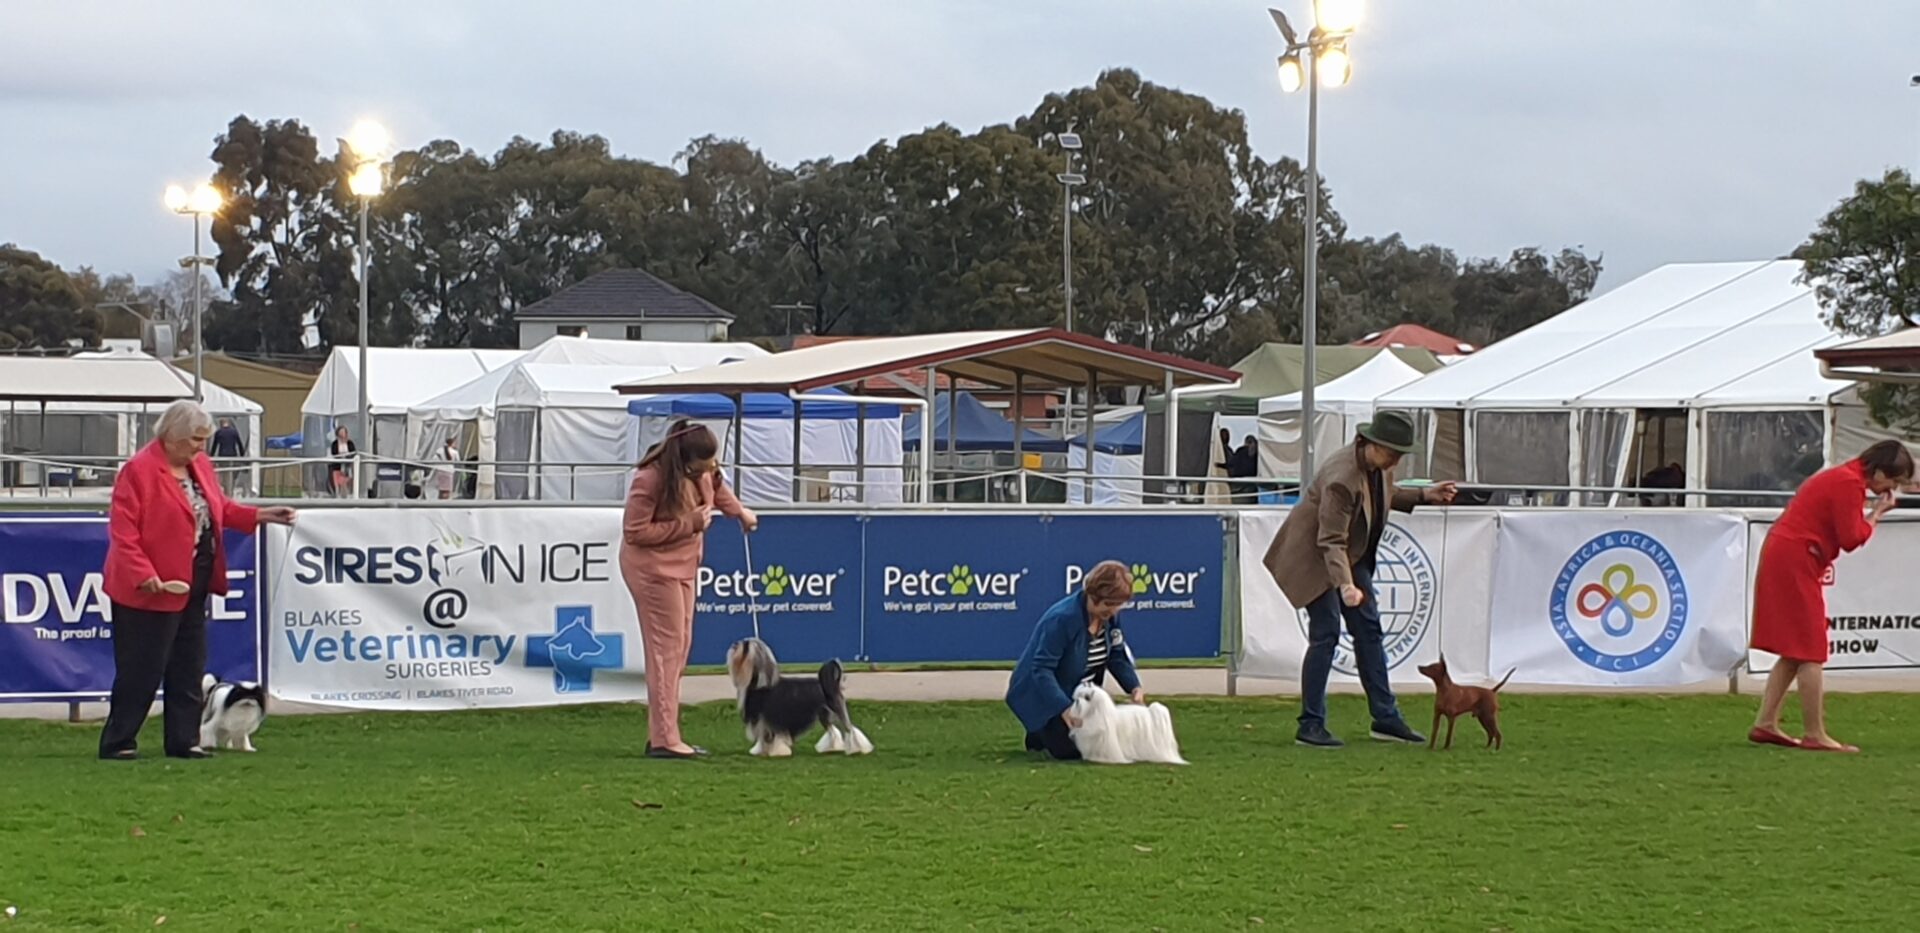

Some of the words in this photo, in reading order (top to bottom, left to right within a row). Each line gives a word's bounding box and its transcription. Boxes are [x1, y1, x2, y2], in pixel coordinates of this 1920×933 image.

[295, 546, 423, 585] SIRES
[541, 542, 610, 583] ICE
[1557, 541, 1601, 593] AFRICA
[1605, 535, 1615, 546] &
[1619, 533, 1677, 578] OCEANIA
[423, 588, 468, 629] @
[696, 602, 726, 612] We've
[728, 603, 746, 614] got
[748, 603, 771, 613] your
[773, 602, 790, 613] pet
[884, 601, 912, 611] We've
[914, 602, 932, 613] got
[933, 602, 956, 613] your
[958, 601, 975, 612] pet
[1136, 600, 1153, 610] pet
[285, 610, 362, 627] BLAKES
[35, 627, 58, 639] The
[61, 626, 96, 641] proof
[100, 627, 111, 638] is
[285, 626, 516, 665] Veterinary
[385, 661, 491, 679] SURGERIES
